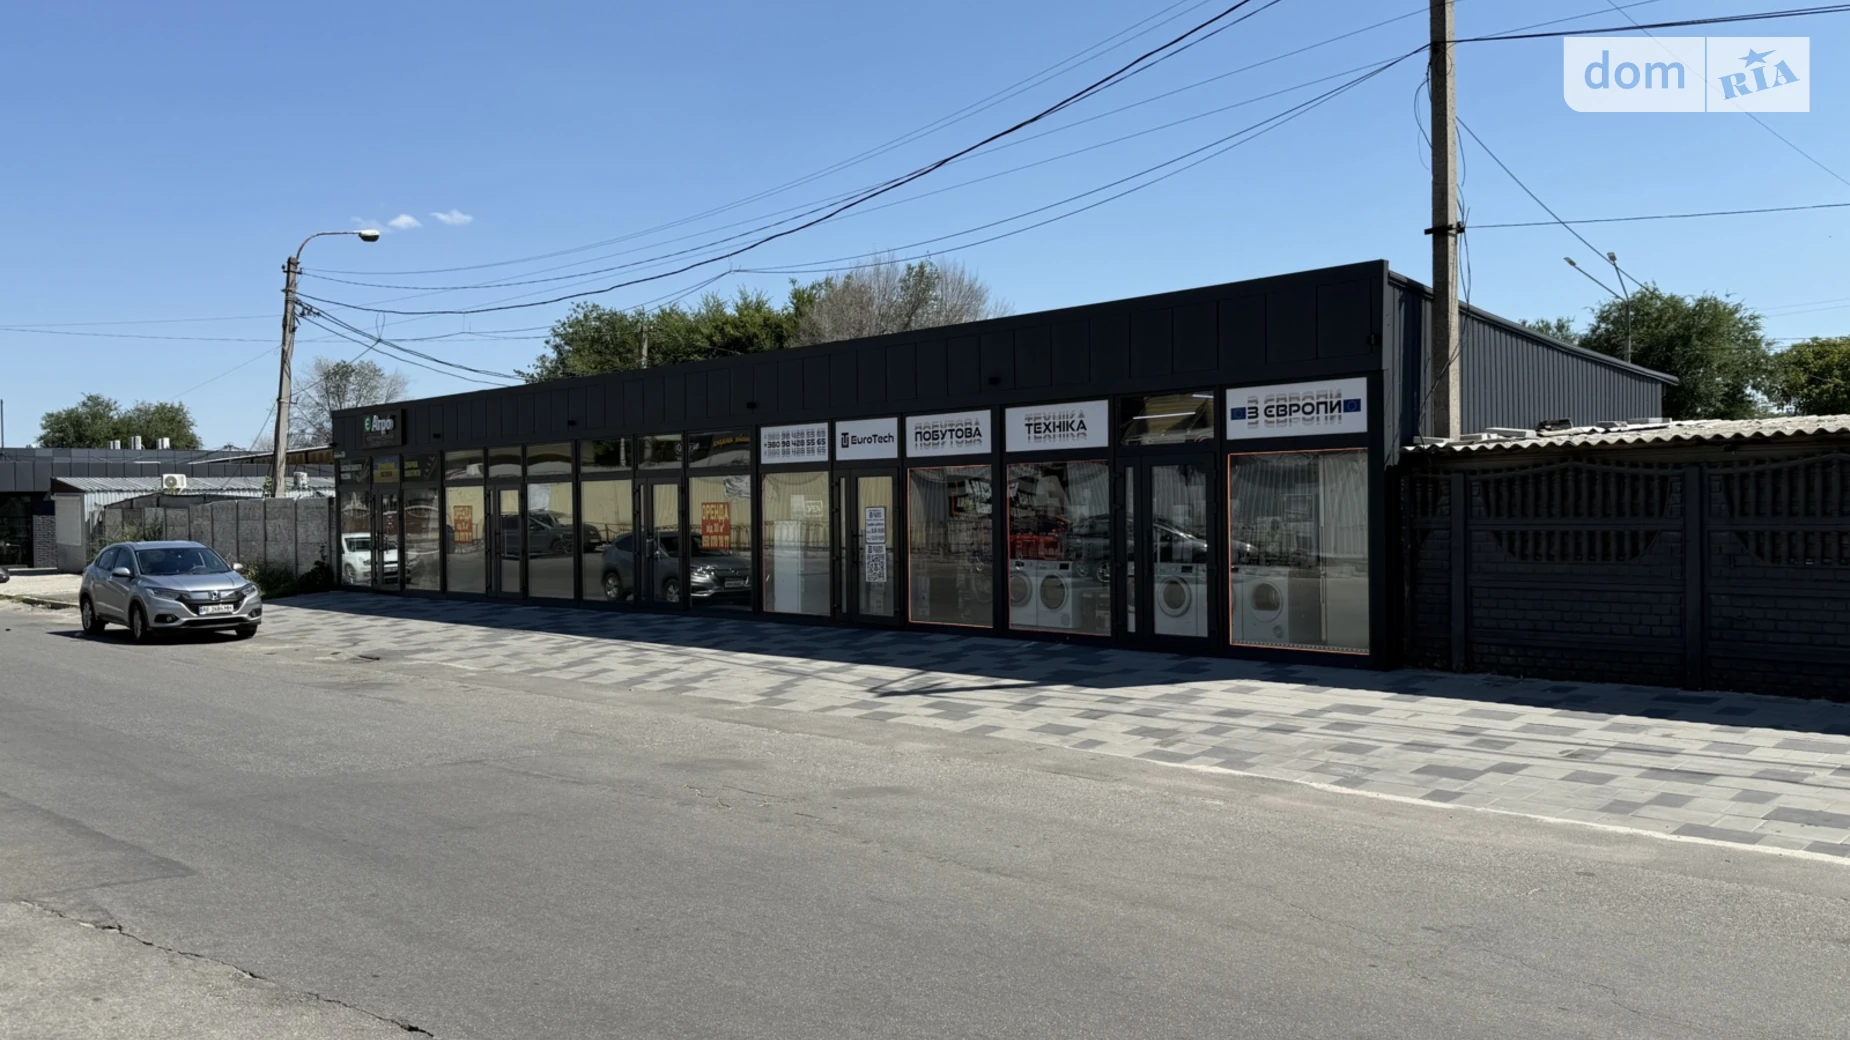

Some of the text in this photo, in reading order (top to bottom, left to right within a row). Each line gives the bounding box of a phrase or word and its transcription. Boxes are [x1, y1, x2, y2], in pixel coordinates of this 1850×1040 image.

[1264, 400, 1342, 418] ЄВРОПИ
[1025, 419, 1087, 434] ТЕХНІКА
[851, 432, 895, 446] EuroTech
[914, 427, 982, 442] ПОБУТОВА
[781, 440, 791, 448] 98
[806, 438, 816, 446] 55
[702, 503, 729, 523] ОРЕНДА
